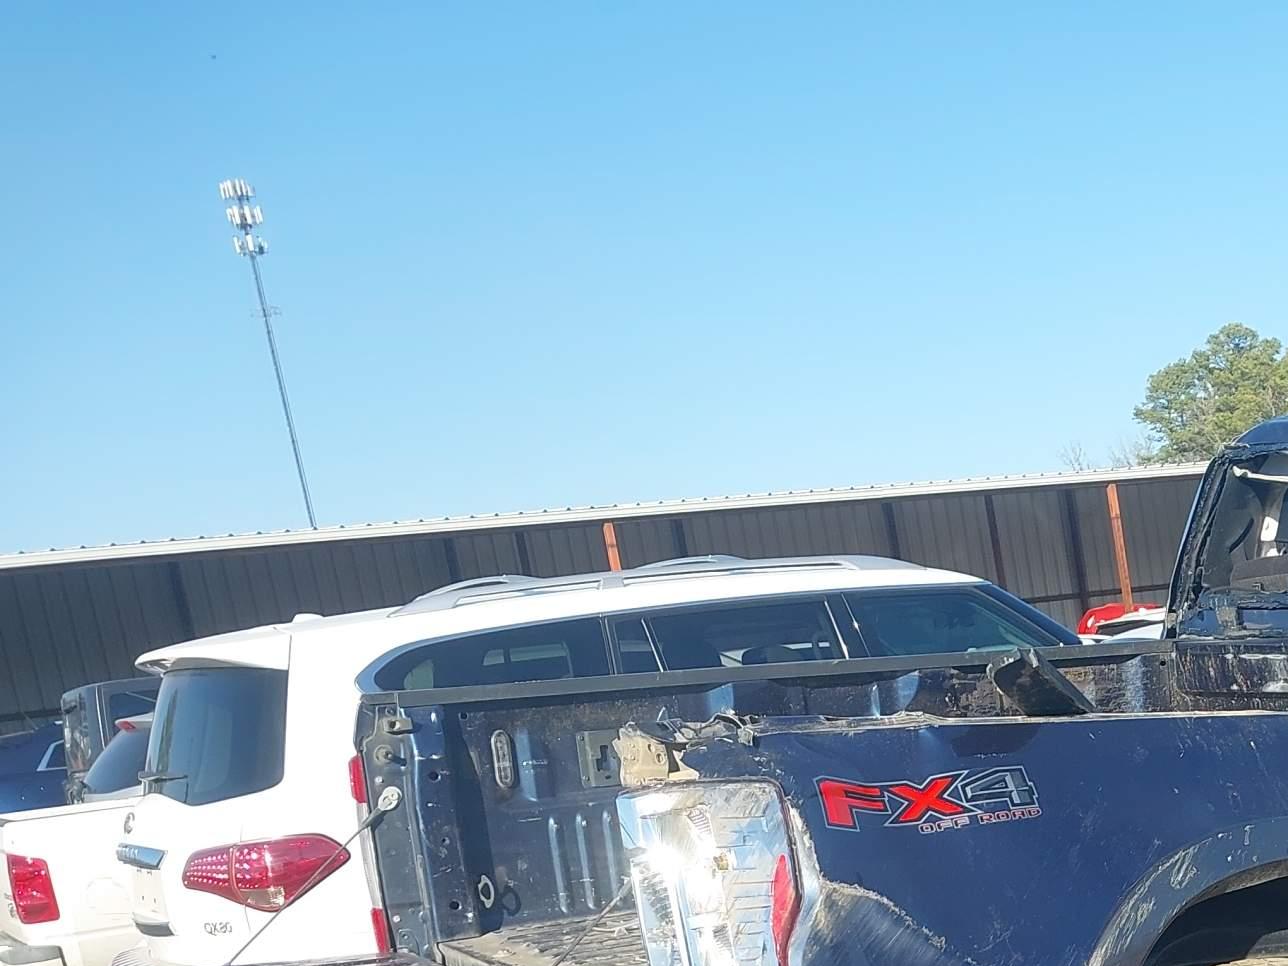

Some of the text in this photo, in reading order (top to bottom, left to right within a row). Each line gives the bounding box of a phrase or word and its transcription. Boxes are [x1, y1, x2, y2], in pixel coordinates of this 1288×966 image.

[814, 766, 1039, 832] FX4
[918, 807, 1042, 834] OFF ROAD
